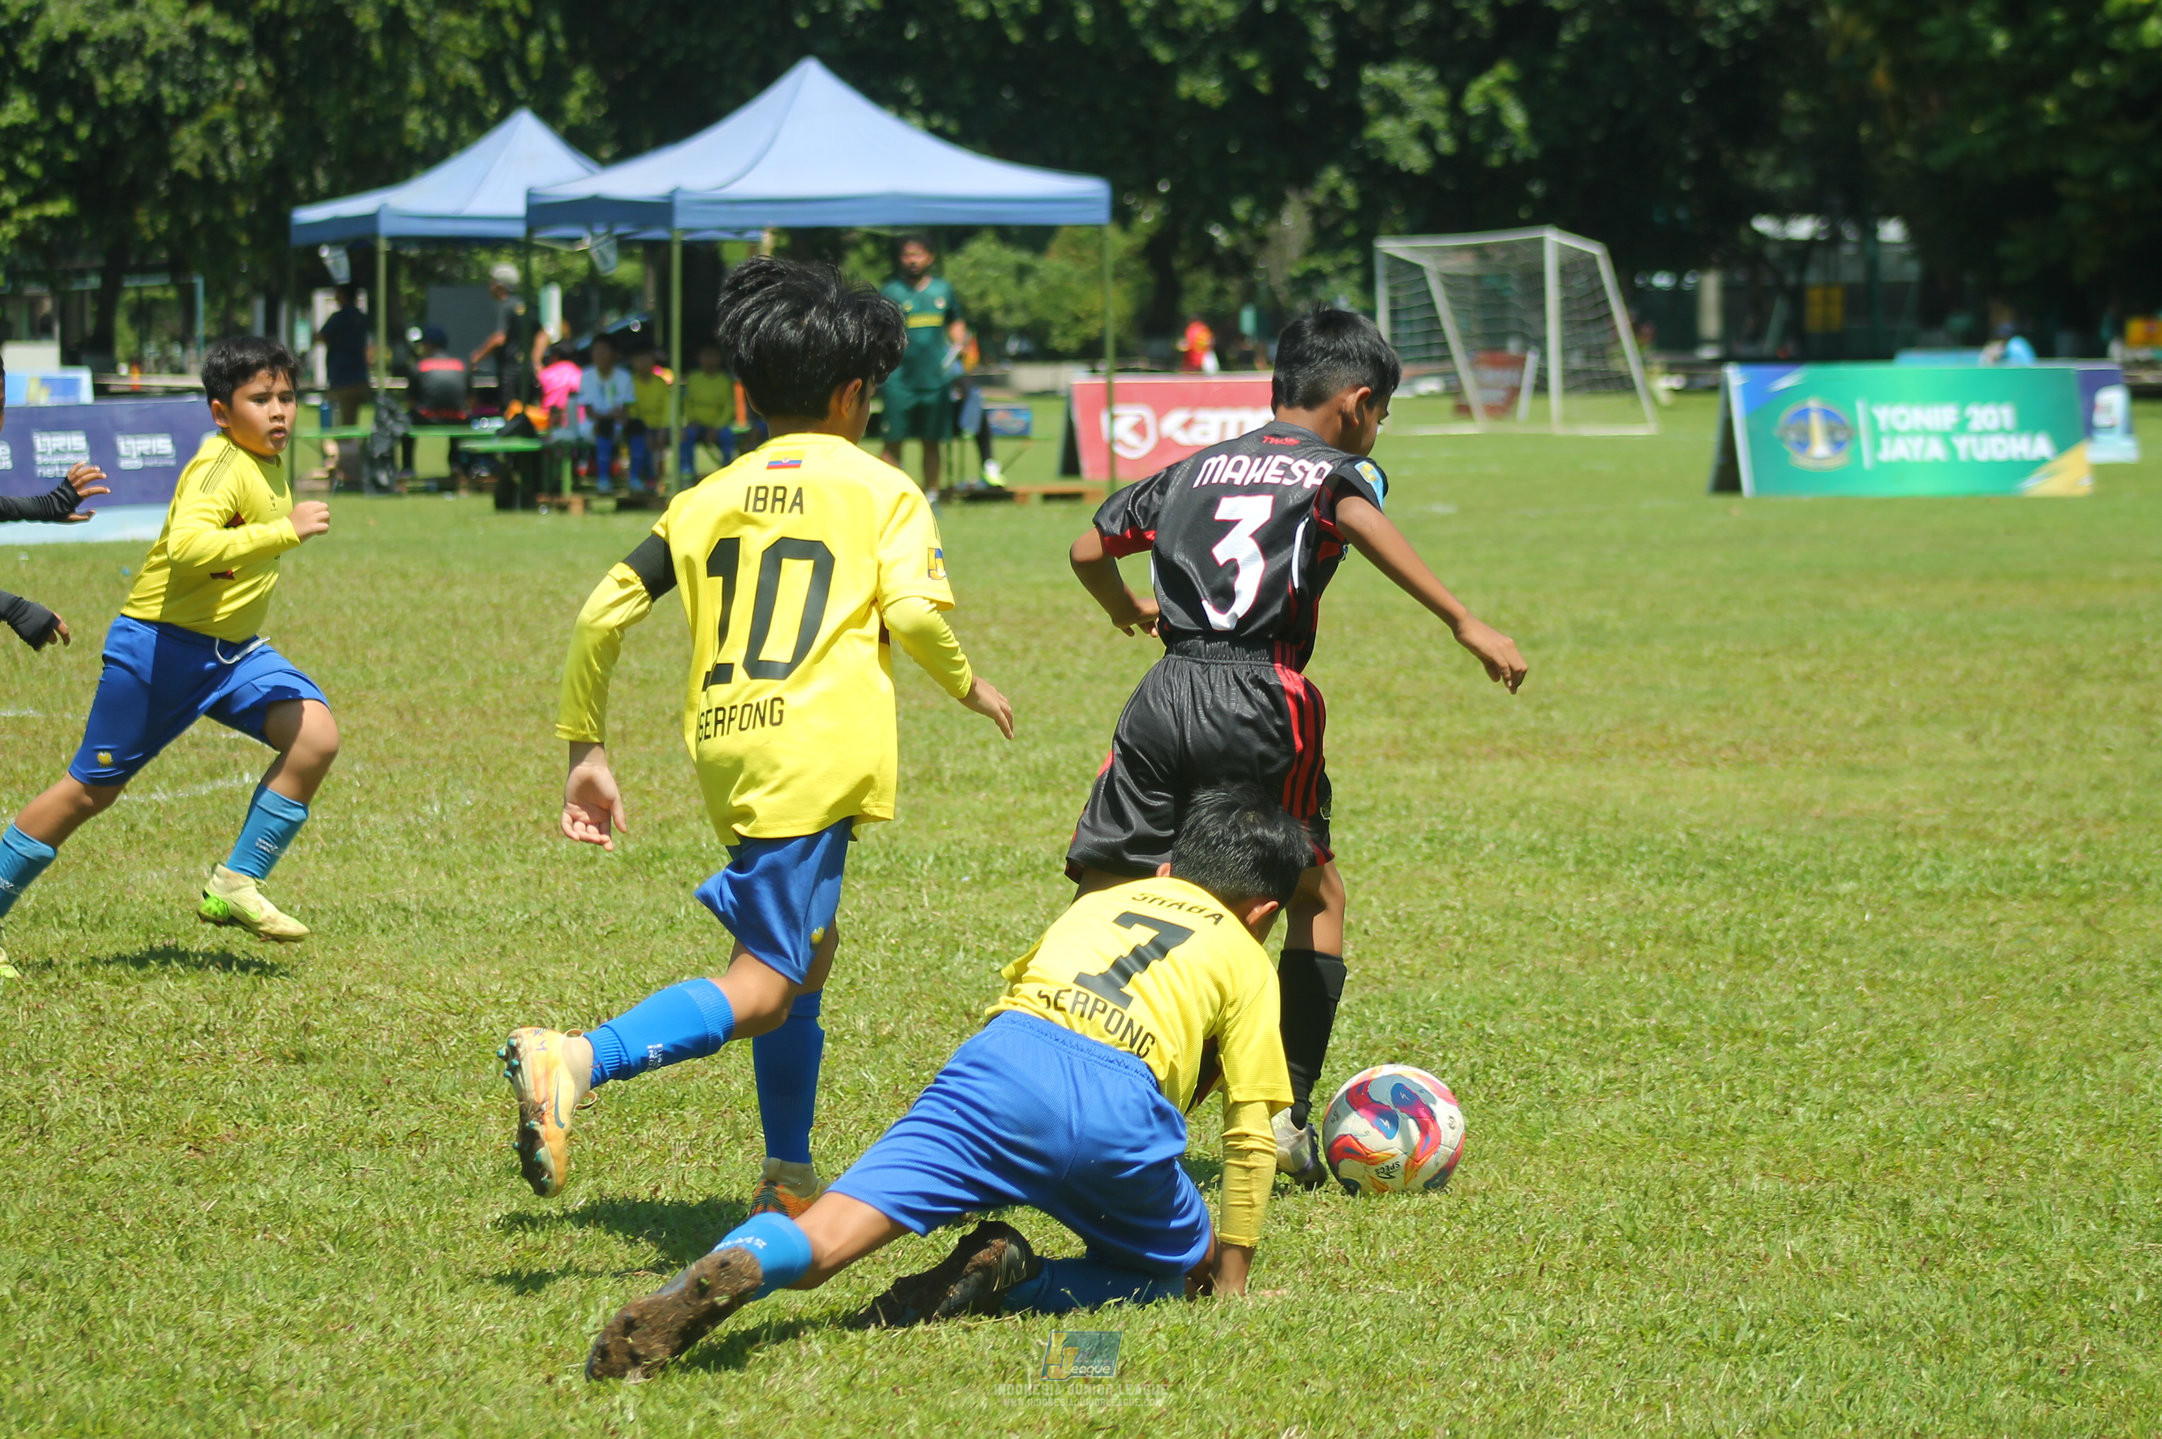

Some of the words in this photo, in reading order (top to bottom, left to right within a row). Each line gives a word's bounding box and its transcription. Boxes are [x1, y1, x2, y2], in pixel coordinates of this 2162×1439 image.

[1872, 403, 1960, 432] YONIF
[1964, 402, 2015, 432] 201
[1877, 432, 1950, 462] JAYA
[1952, 431, 2057, 461] YUDHA
[1192, 454, 1334, 489] MAHESA
[744, 486, 804, 515] IBRA
[1201, 494, 1275, 631] 3
[702, 536, 835, 692] 10
[698, 697, 785, 742] SERPONG
[1073, 911, 1196, 1010] 7
[1037, 988, 1156, 1059] SERPONG
